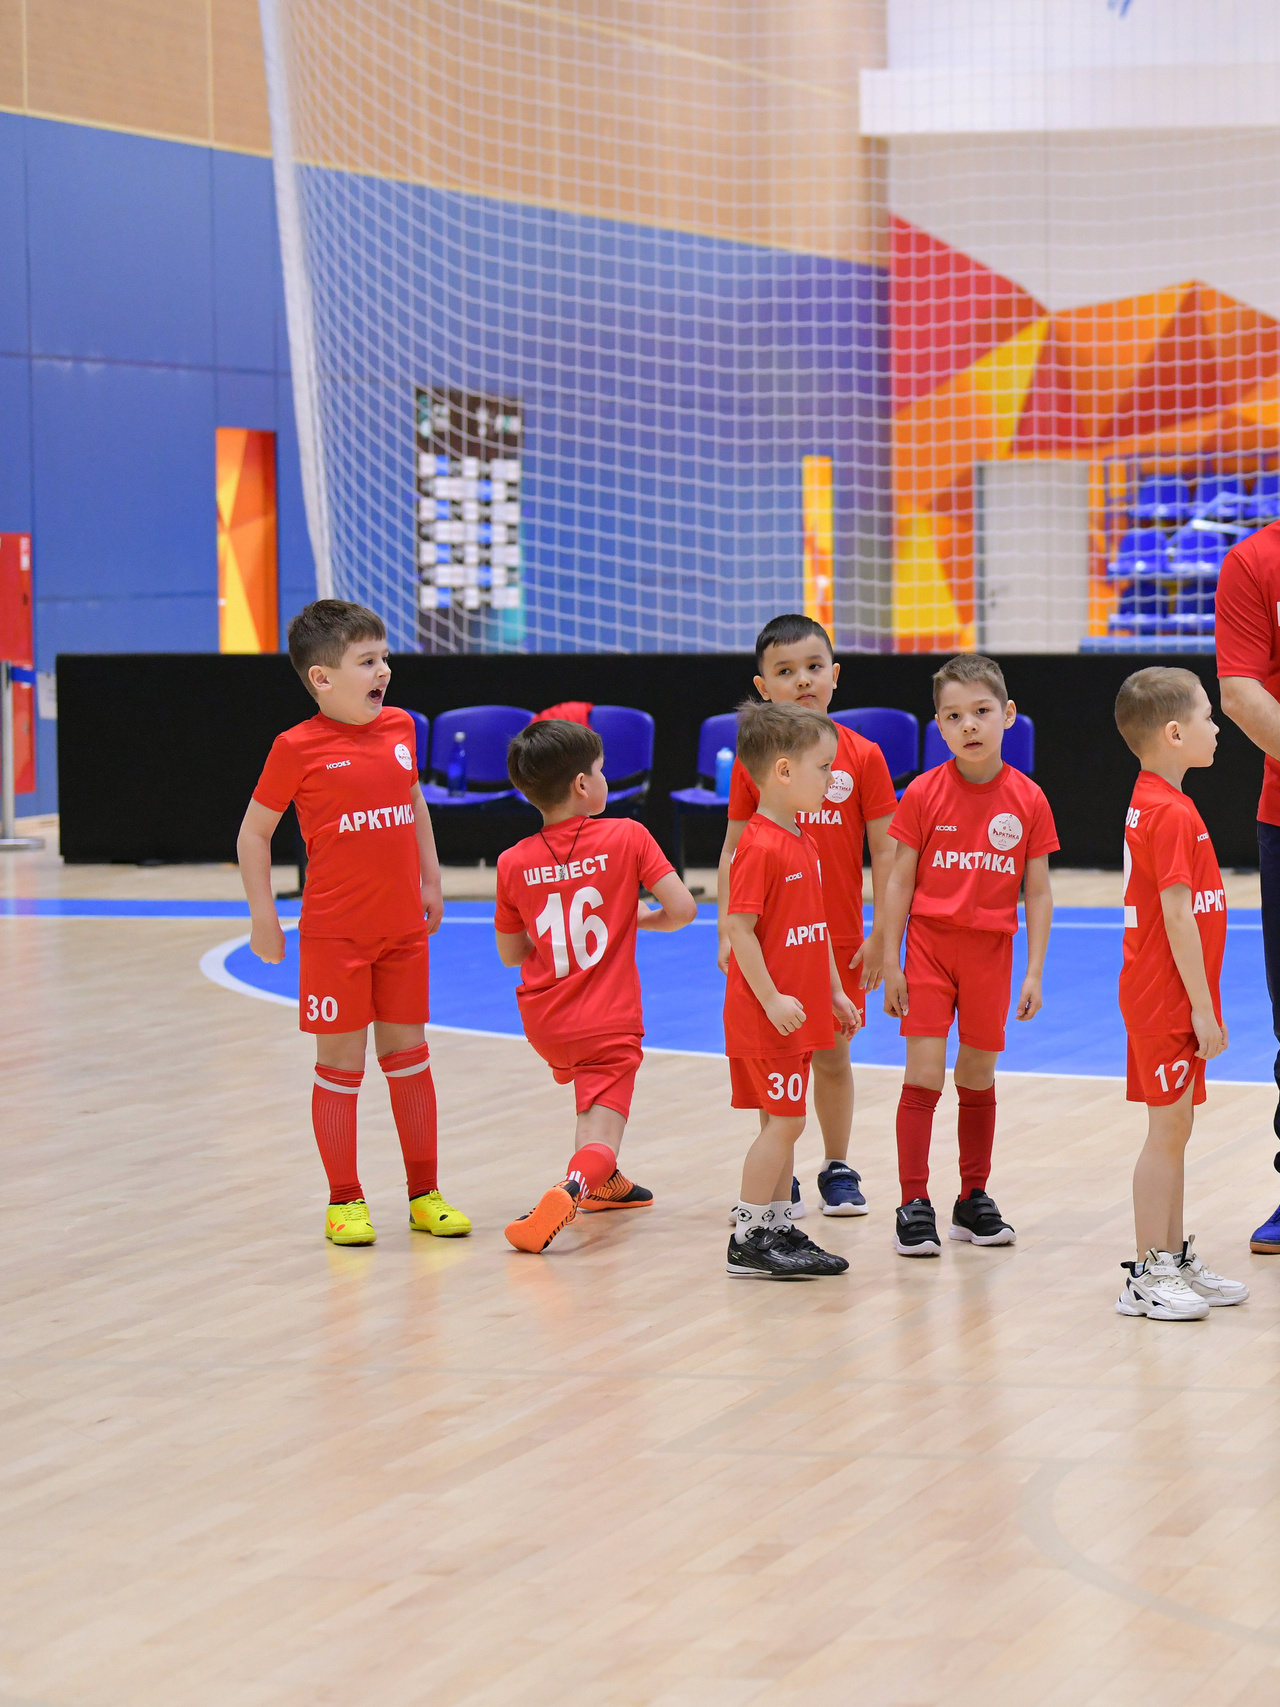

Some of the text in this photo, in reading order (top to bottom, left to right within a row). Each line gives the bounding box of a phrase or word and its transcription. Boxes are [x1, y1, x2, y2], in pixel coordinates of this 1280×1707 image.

[326, 760, 351, 770] KODES
[794, 809, 843, 825] ТИКА
[523, 854, 609, 886] ШЕЛЕСТ
[932, 850, 1017, 875] АРКТИКА
[535, 886, 609, 979] 16
[306, 994, 338, 1022] 30
[767, 1072, 803, 1101] 30
[1154, 1059, 1190, 1092] 12
